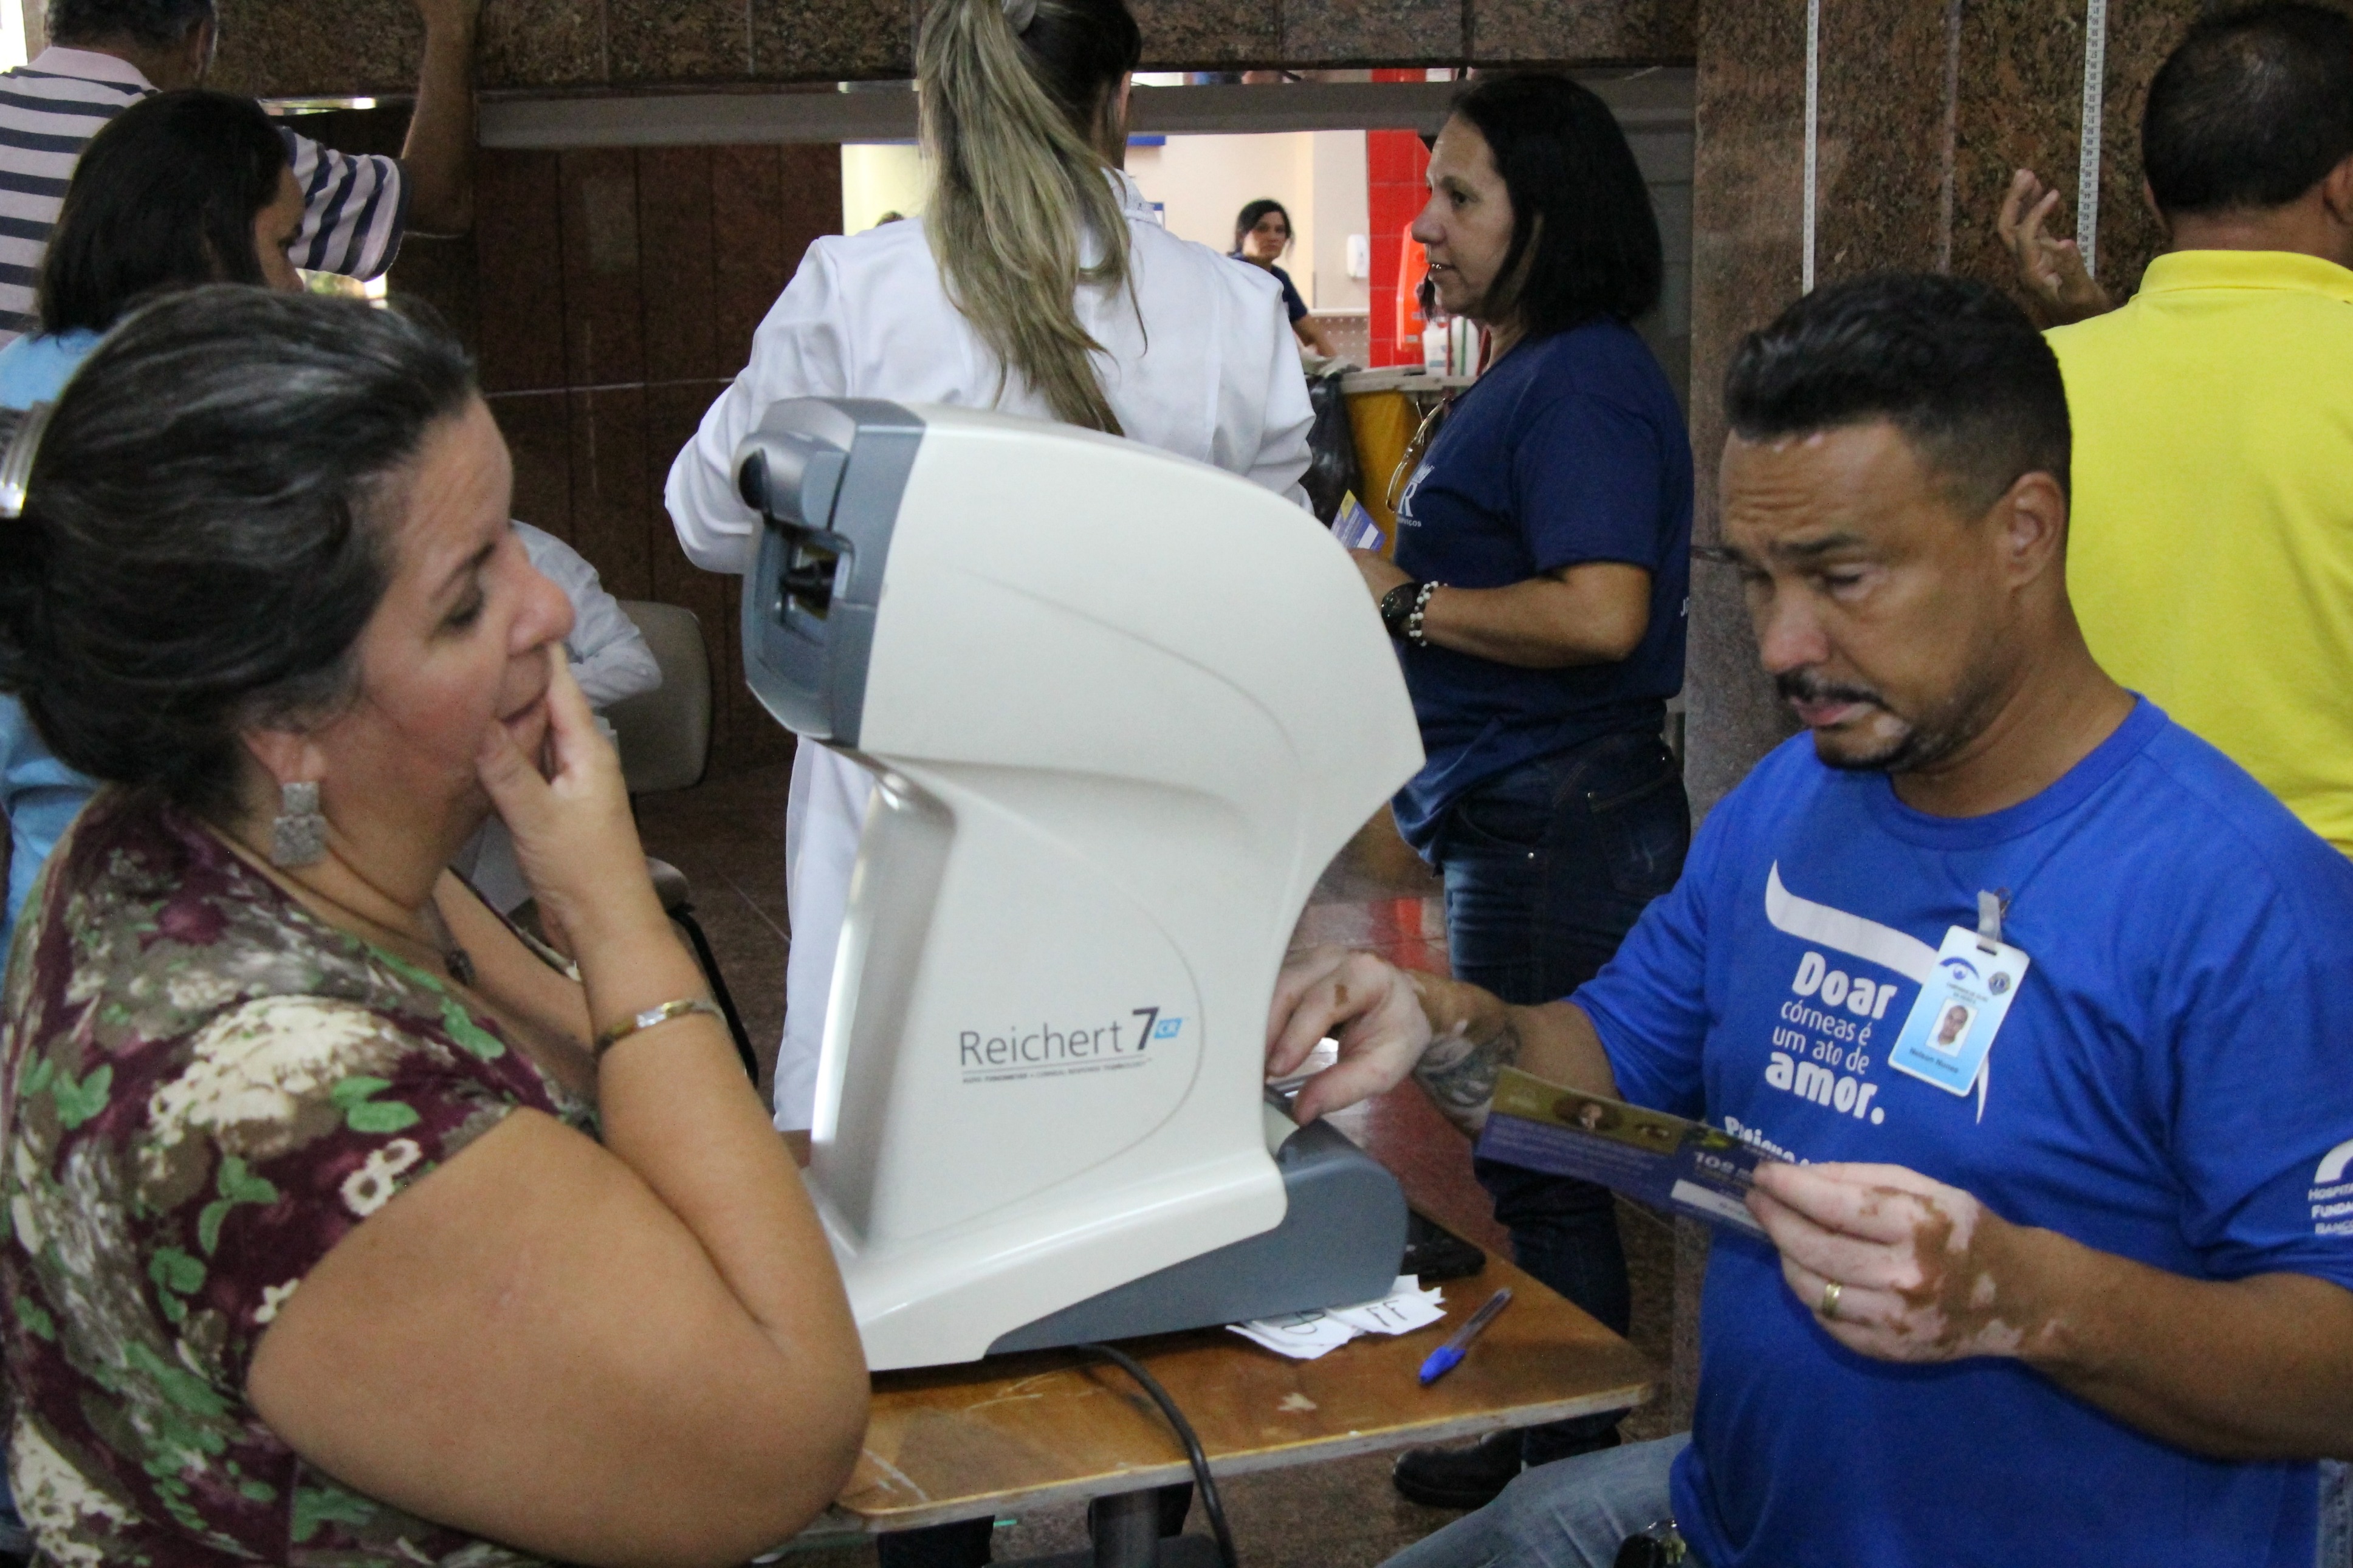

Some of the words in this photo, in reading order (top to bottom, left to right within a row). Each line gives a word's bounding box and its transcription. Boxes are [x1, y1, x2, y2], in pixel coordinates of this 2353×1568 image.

[1792, 951, 1898, 1019] Doar
[960, 1021, 1123, 1066] Reichert
[1132, 1005, 1159, 1050] 7
[1772, 1025, 1806, 1053] um
[1812, 1040, 1843, 1065] ato
[1846, 1046, 1870, 1075] de
[1781, 999, 1857, 1041] córneas
[1858, 1021, 1872, 1046] é
[1765, 1051, 1884, 1125] amor.
